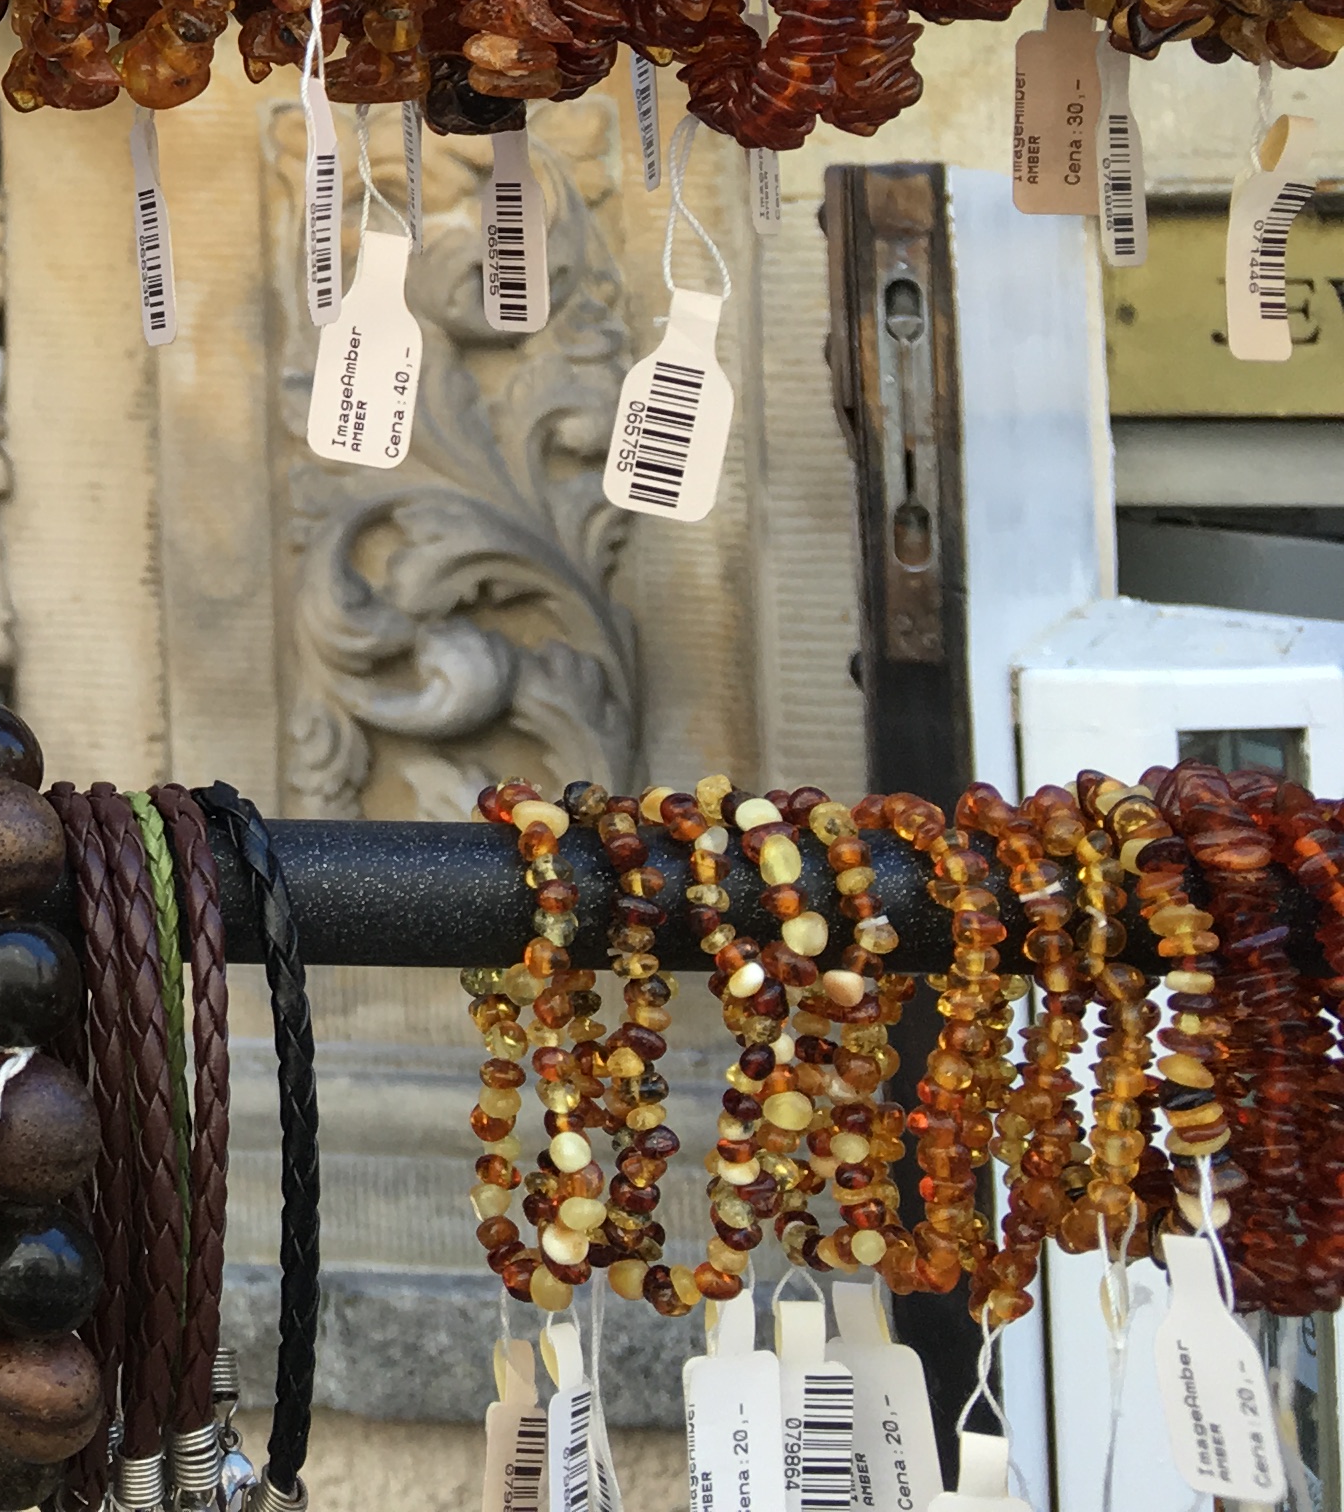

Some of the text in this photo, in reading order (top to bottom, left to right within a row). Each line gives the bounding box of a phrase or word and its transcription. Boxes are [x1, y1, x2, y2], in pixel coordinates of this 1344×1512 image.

[1028, 134, 1040, 184] AMBER
[487, 225, 499, 297] 065755
[1248, 219, 1264, 295] 071446
[331, 326, 363, 448] ImageAmber
[351, 401, 368, 452] AMBER
[615, 399, 646, 474] 065755
[1177, 1340, 1214, 1476] ImageAmber
[785, 1418, 802, 1491] 079864
[855, 1452, 875, 1506] AMBER
[701, 1471, 713, 1512] MBER
